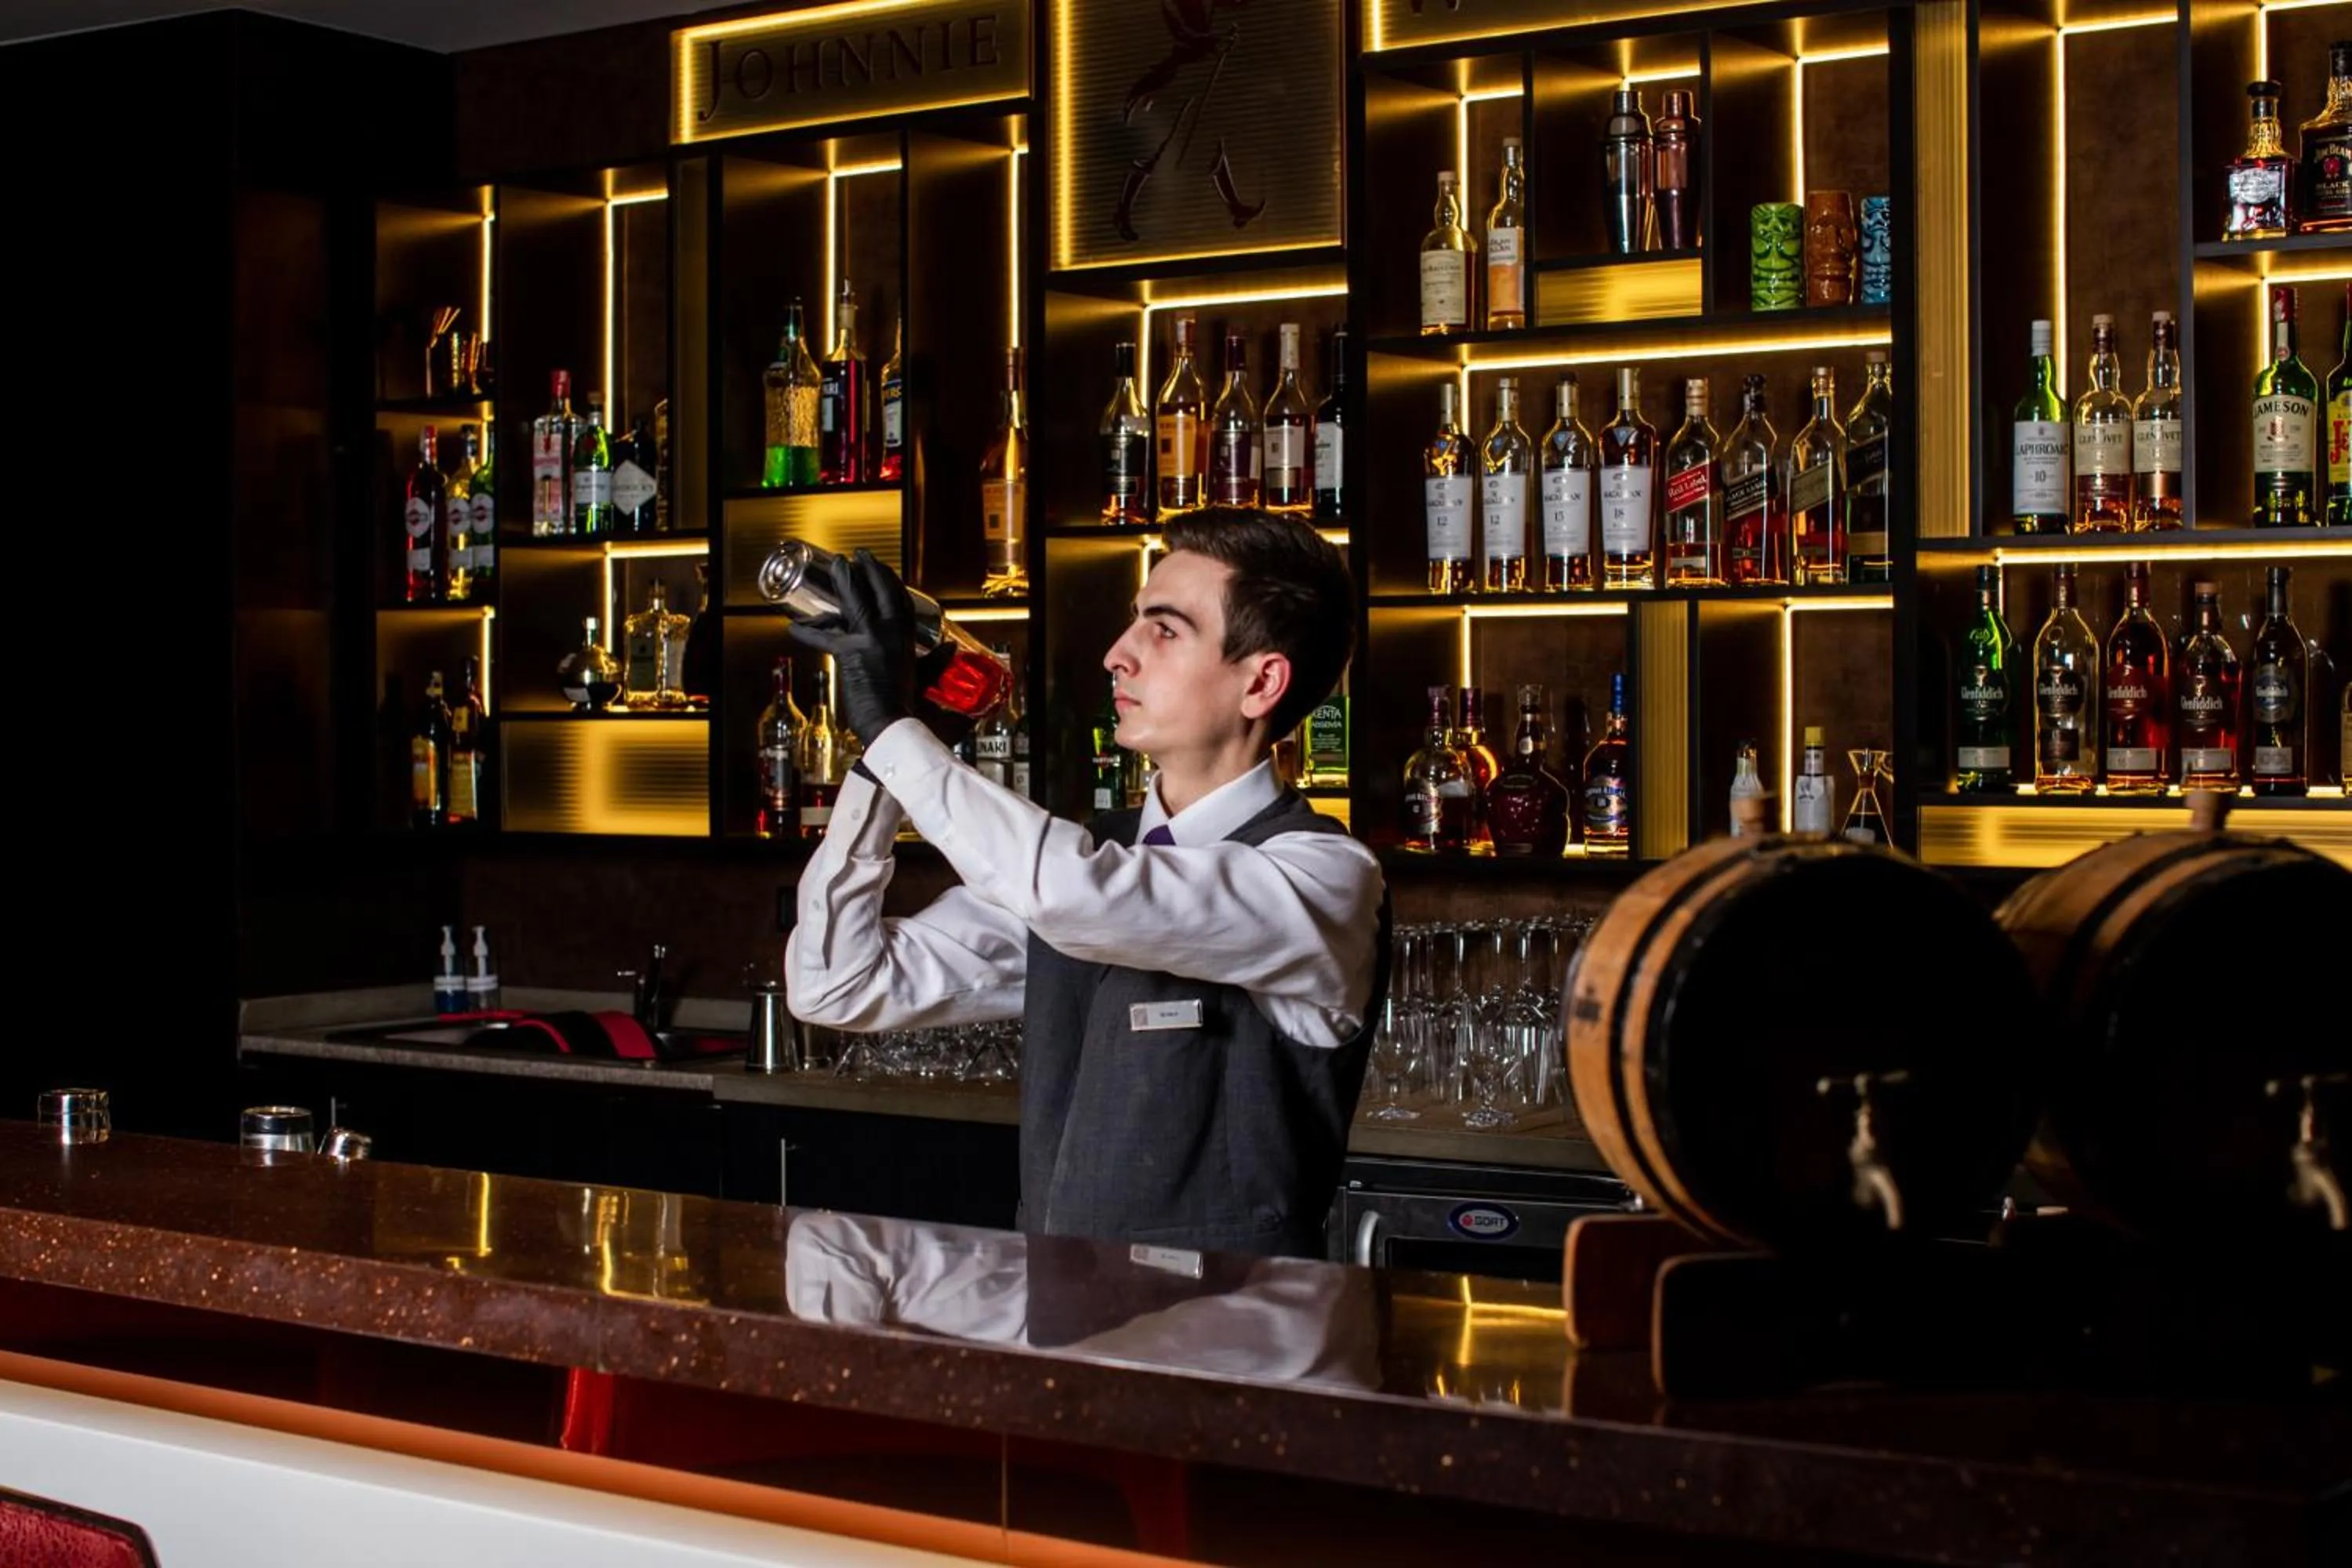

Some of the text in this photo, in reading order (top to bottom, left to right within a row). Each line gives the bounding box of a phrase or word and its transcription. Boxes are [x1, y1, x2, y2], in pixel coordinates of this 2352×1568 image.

[699, 14, 1000, 122] JOHNNIE
[2253, 401, 2309, 419] JAMESON
[2034, 470, 2046, 482] 10
